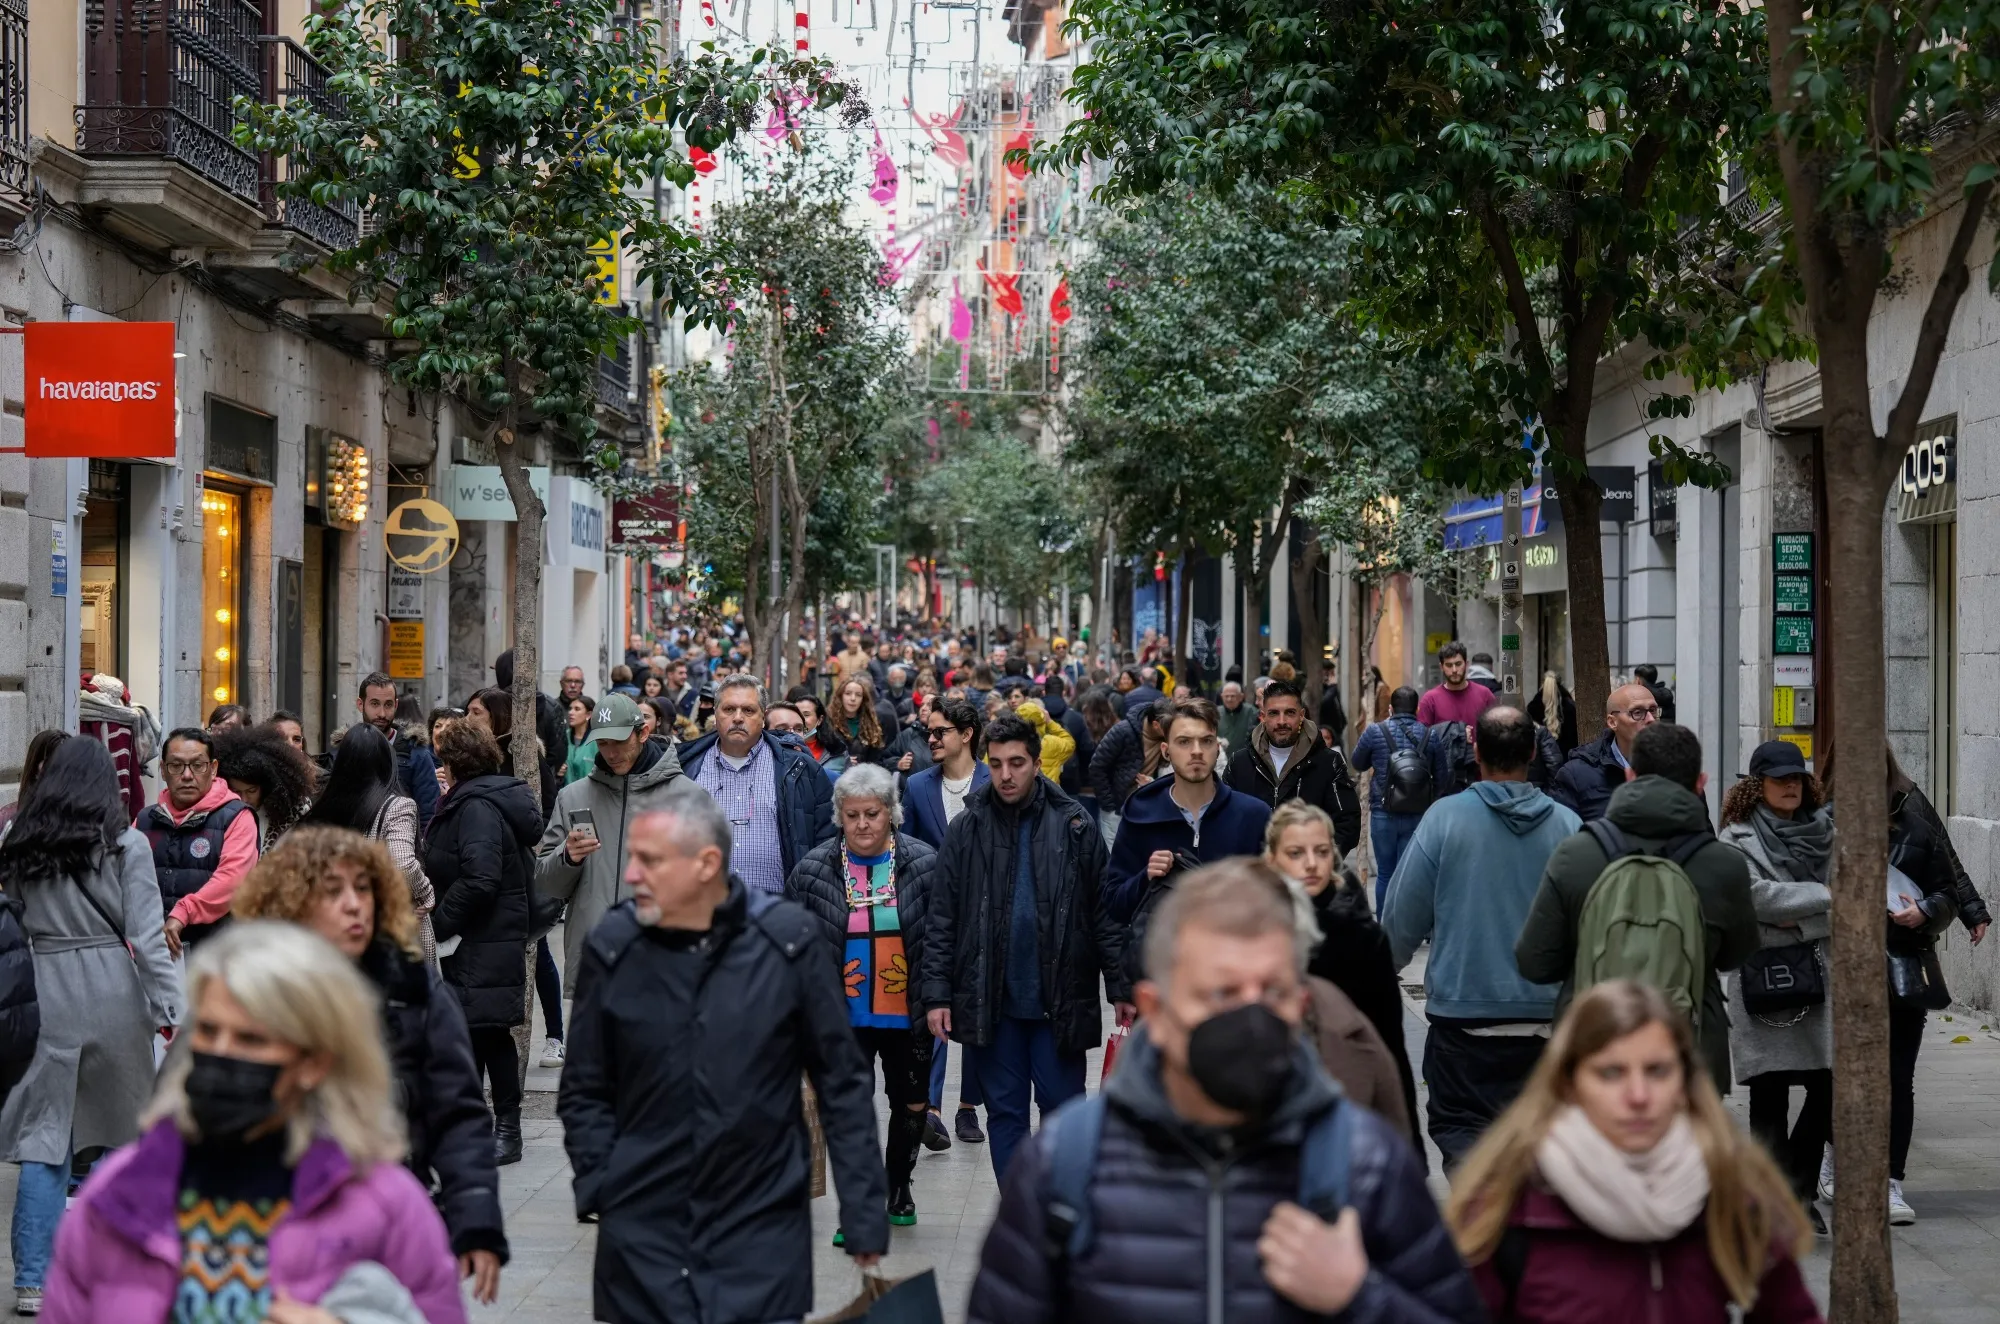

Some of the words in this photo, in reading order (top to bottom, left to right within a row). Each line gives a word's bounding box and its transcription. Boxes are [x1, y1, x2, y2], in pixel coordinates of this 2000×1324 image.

[40, 377, 157, 402] havaianas
[1602, 487, 1633, 499] Jeans
[1777, 535, 1809, 544] FUNDACION
[1781, 545, 1805, 553] SEXPOL
[1777, 562, 1809, 570] SEXOLOGIA
[391, 577, 422, 587] PALACIOS
